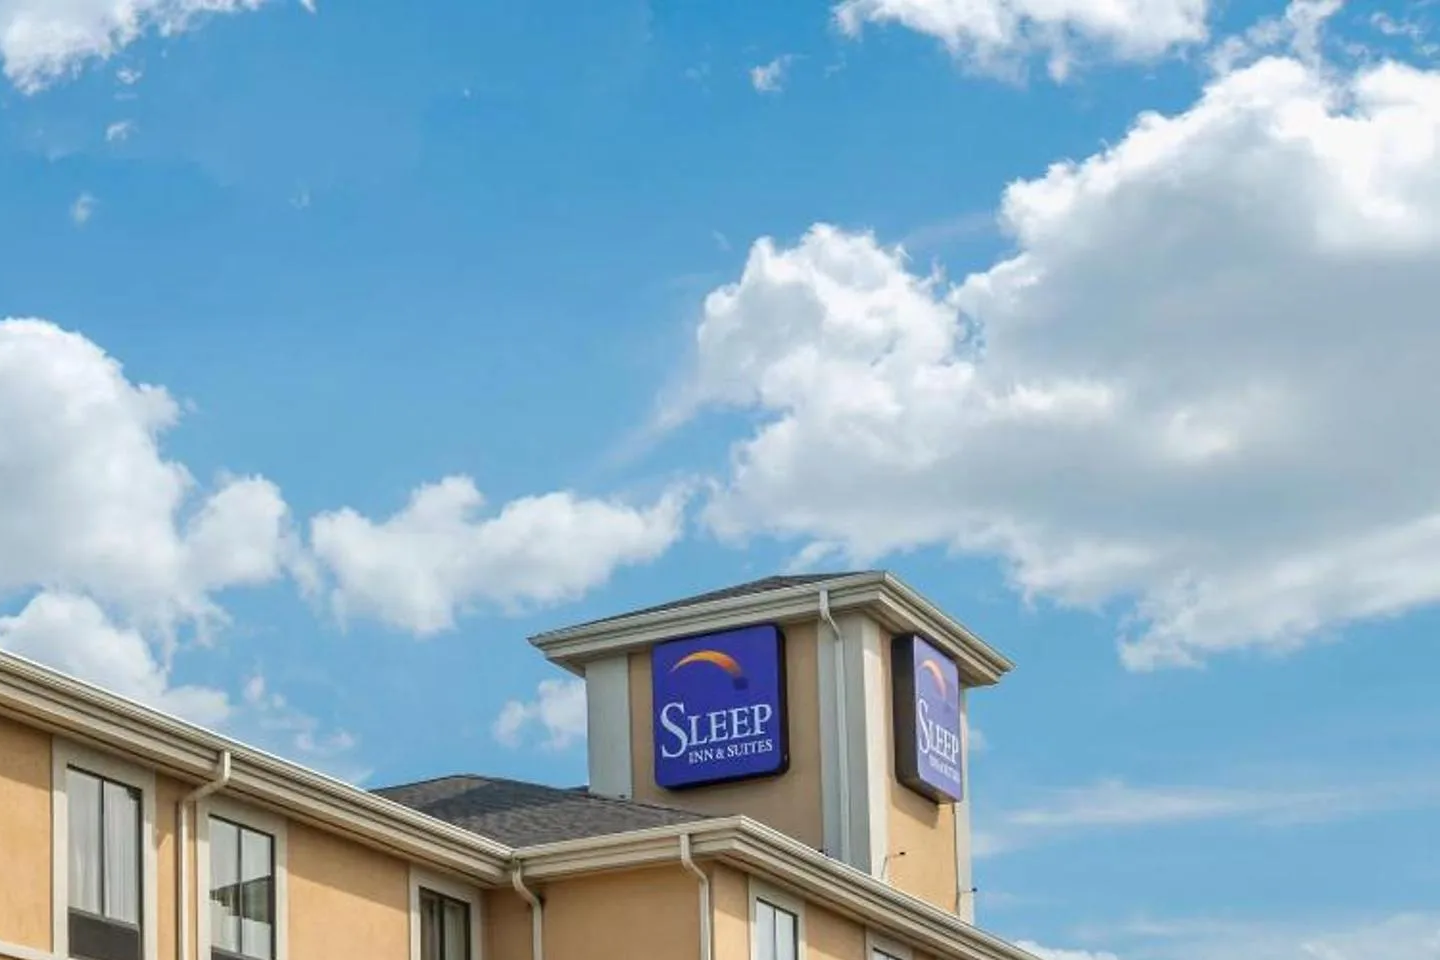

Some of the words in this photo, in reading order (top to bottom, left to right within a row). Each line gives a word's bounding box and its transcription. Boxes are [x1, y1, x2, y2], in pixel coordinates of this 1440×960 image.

[660, 702, 773, 758] SLEEP
[688, 748, 714, 764] INN
[715, 747, 725, 760] &
[727, 739, 773, 758] SUITES
[918, 698, 959, 765] SLEEP
